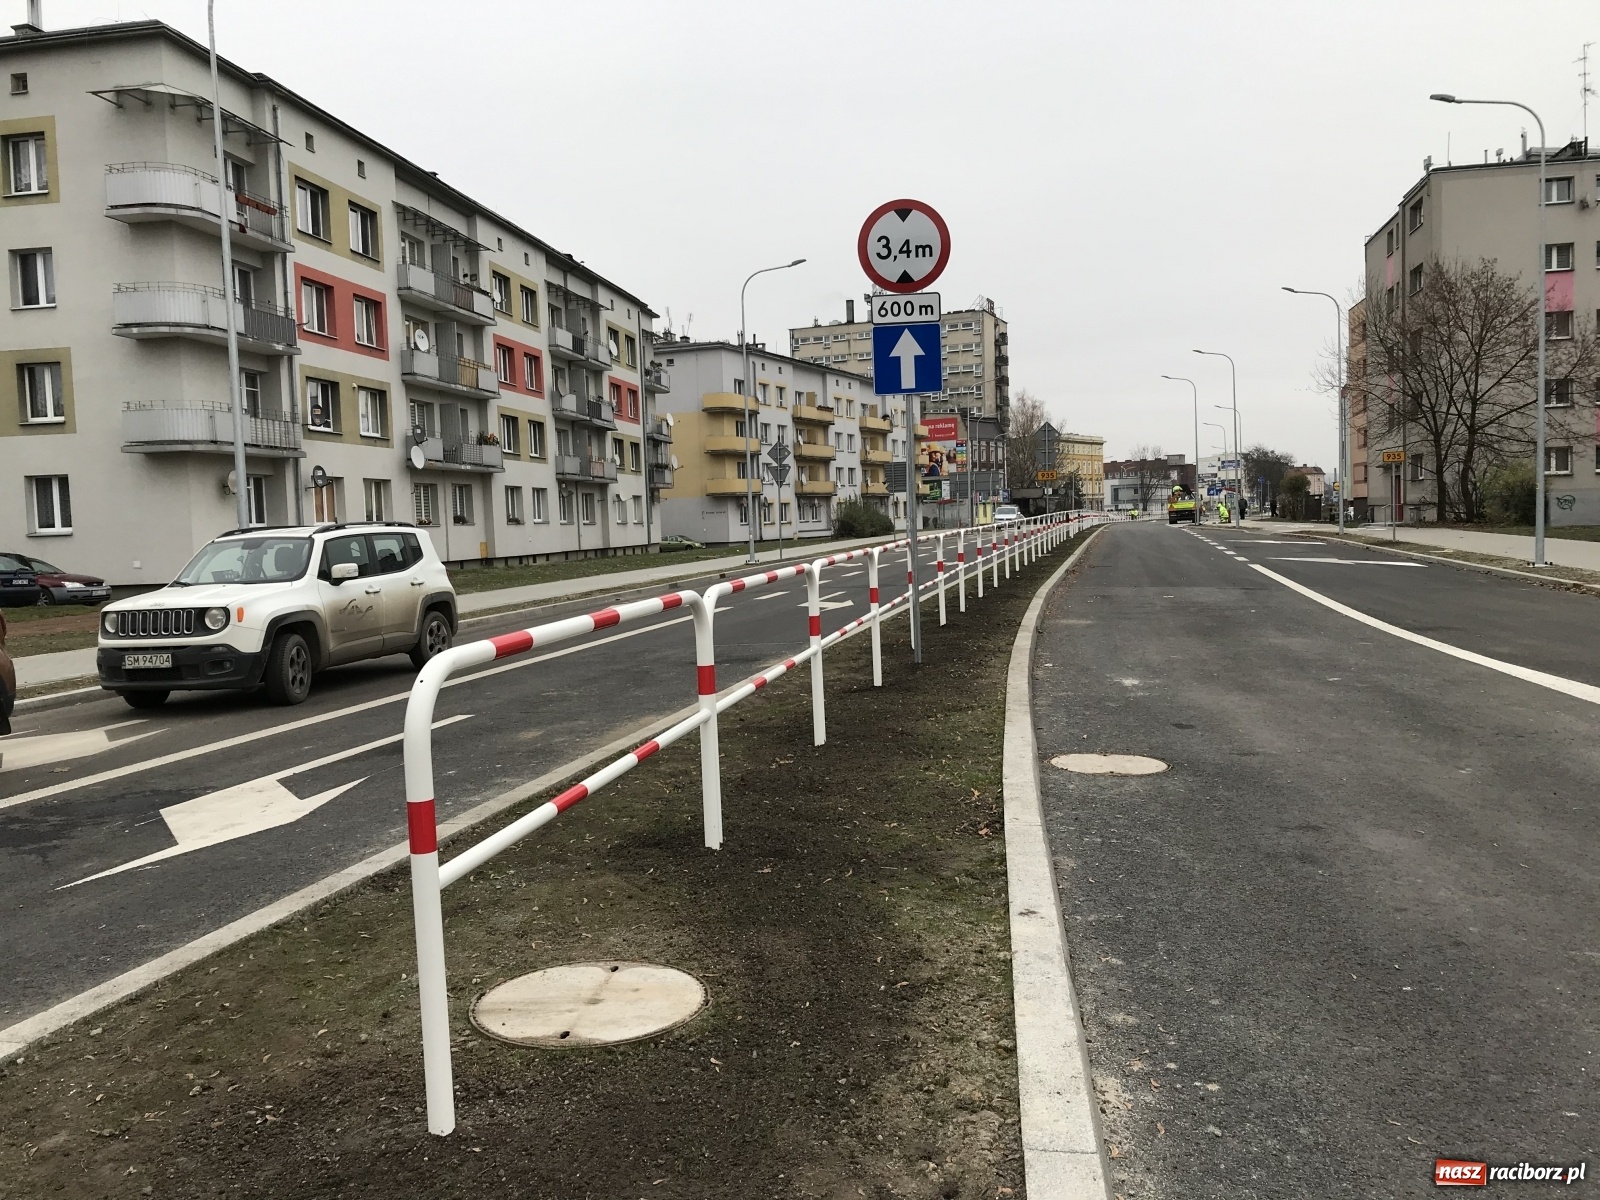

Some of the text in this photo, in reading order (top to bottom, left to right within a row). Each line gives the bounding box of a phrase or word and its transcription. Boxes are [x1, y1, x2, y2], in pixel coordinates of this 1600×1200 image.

[878, 300, 934, 318] 600 m
[126, 654, 171, 666] SM 94704
